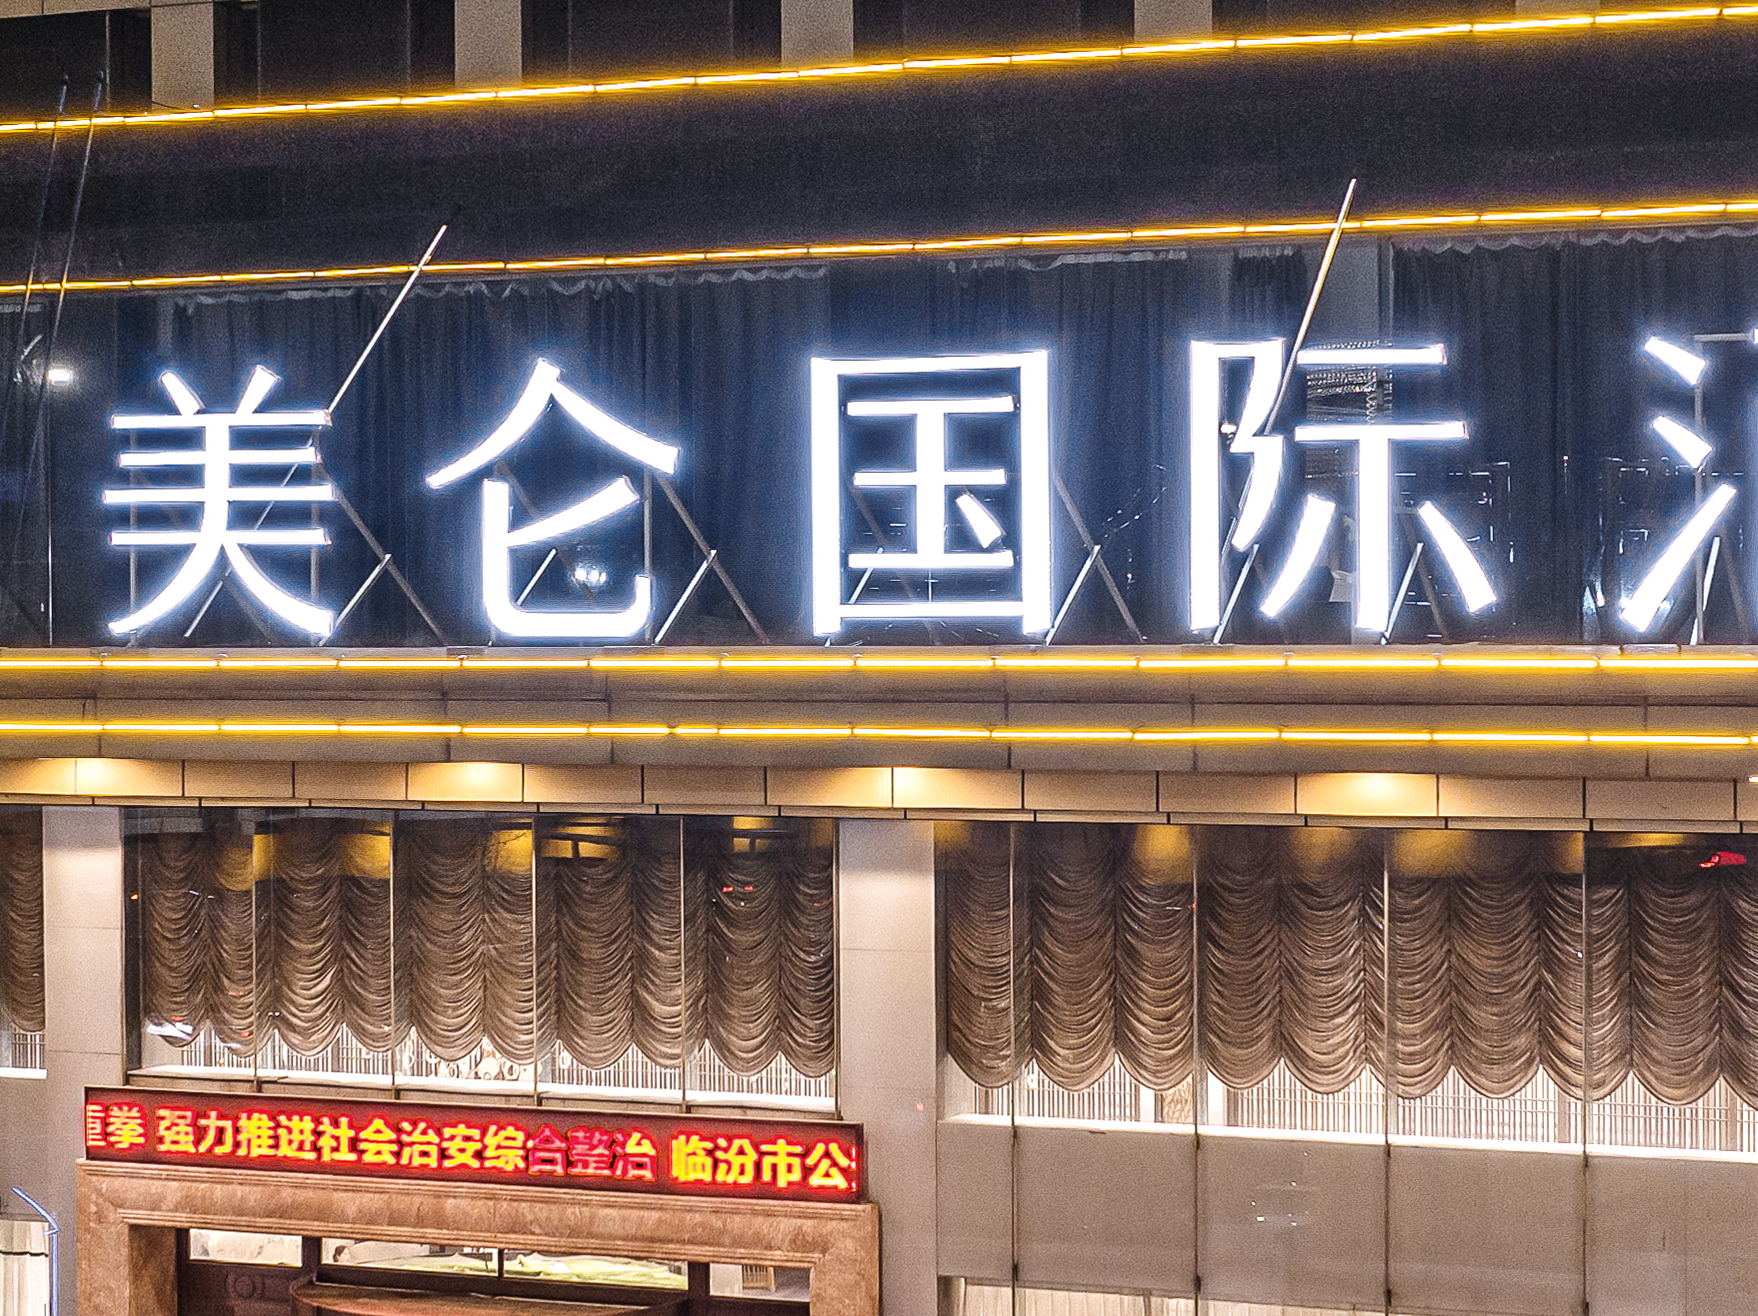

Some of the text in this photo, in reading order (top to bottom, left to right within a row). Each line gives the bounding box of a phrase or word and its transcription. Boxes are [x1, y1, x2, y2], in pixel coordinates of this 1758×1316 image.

[156, 1107, 656, 1182] 强力推进社会治安综合整治
[671, 1133, 857, 1192] 临汾市公
